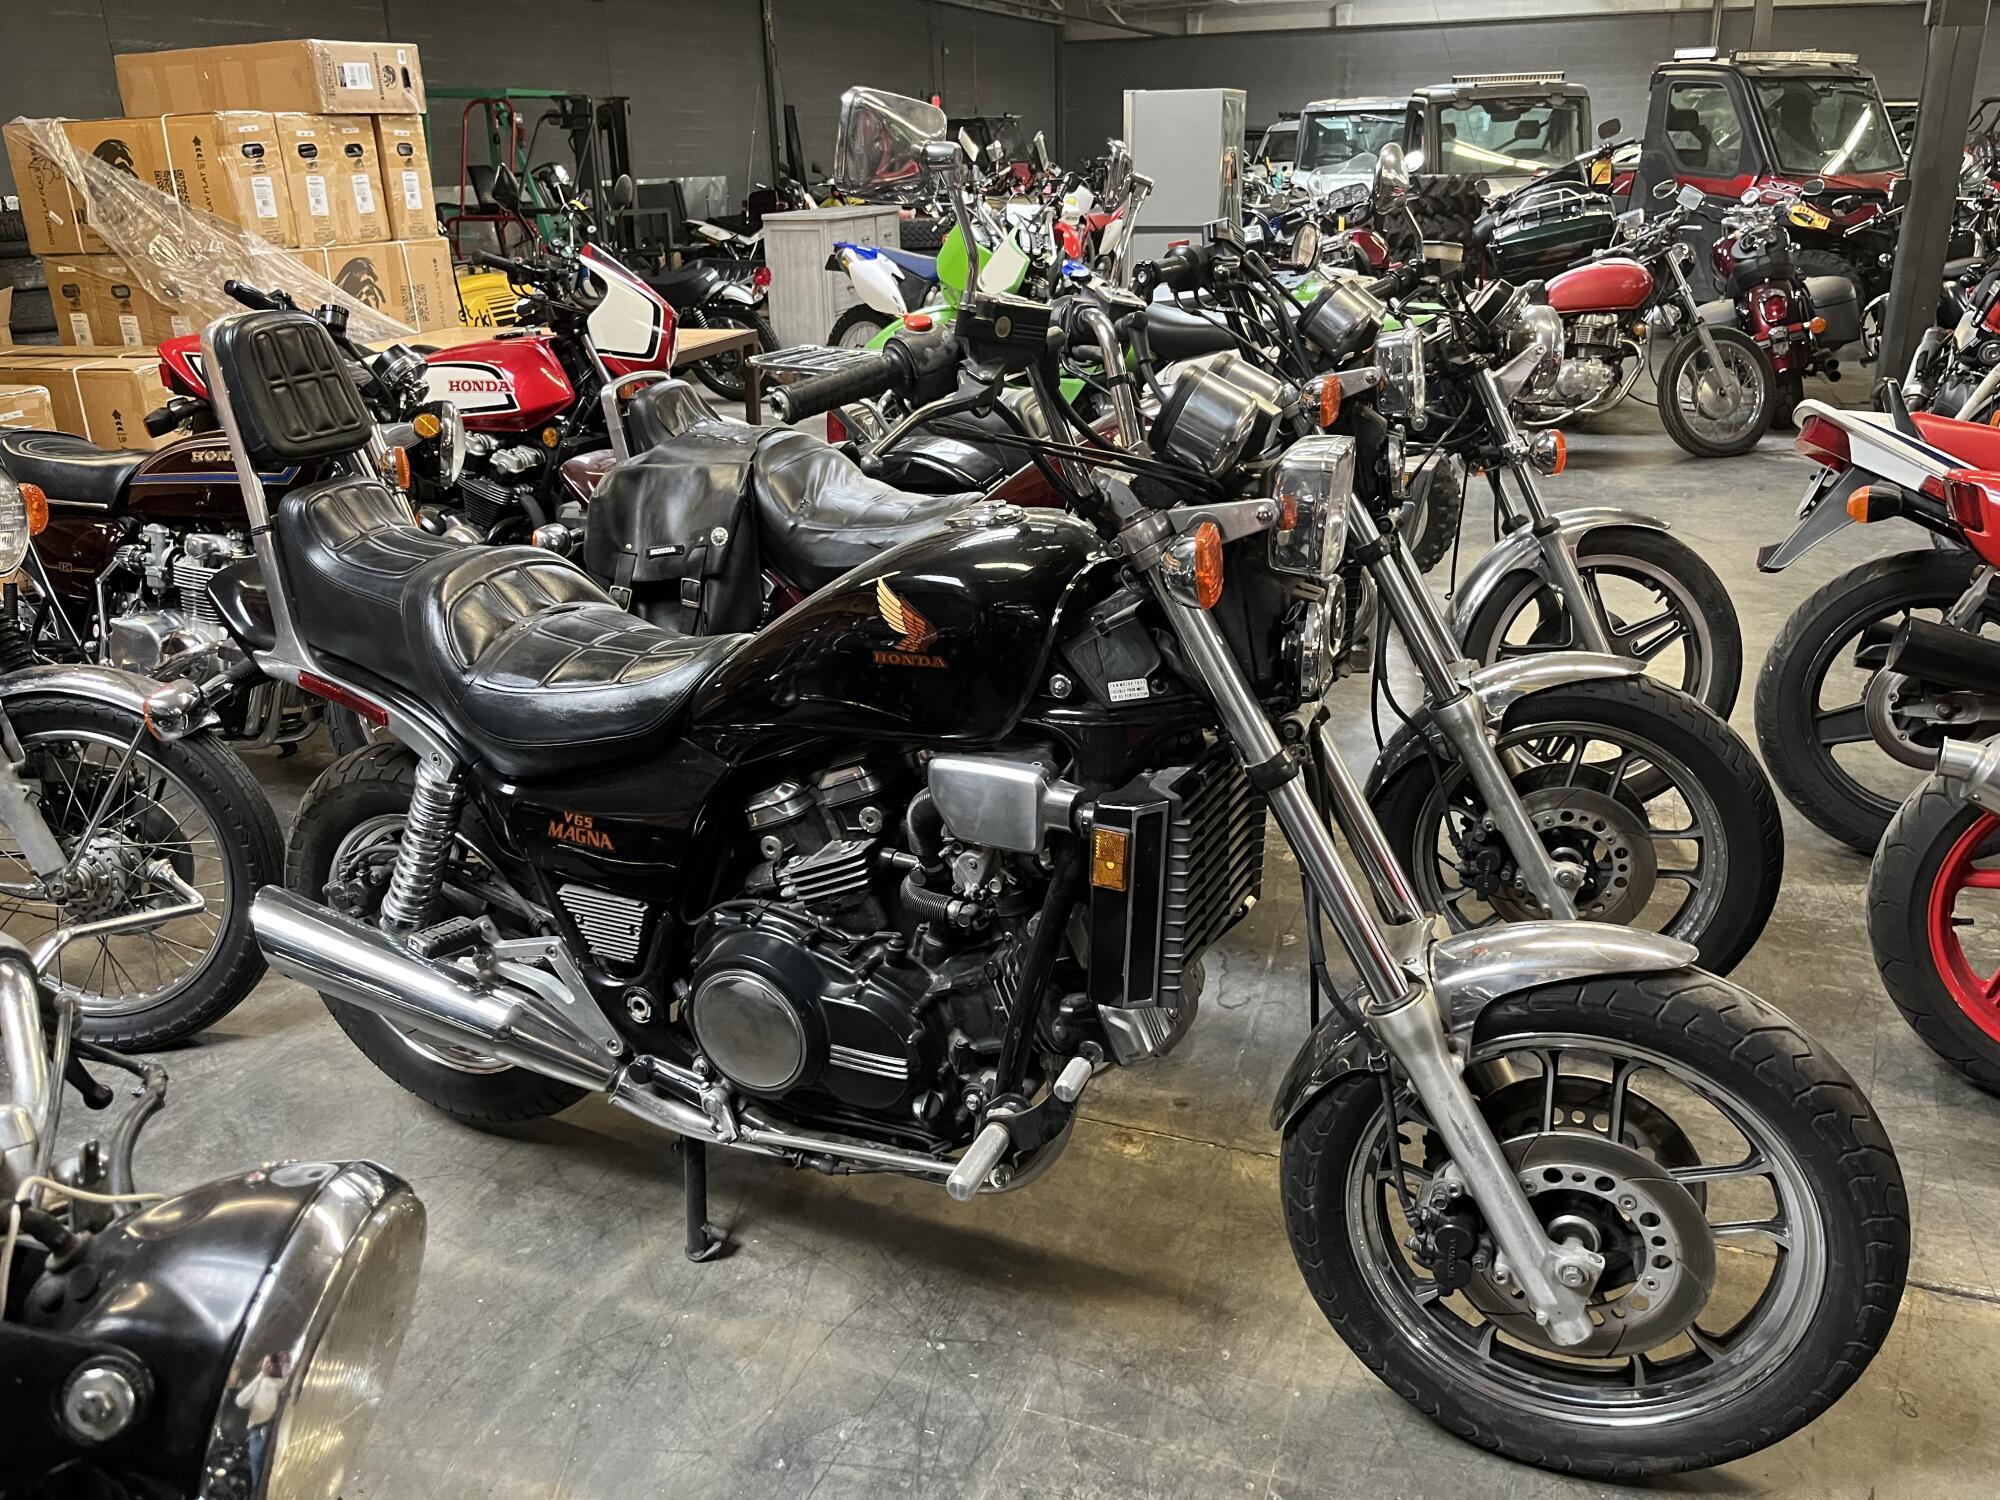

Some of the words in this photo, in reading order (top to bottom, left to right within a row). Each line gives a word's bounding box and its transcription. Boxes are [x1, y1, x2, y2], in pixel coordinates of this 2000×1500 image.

[200, 172, 209, 194] FLAT
[204, 196, 213, 212] LAY
[449, 380, 512, 392] HONDA
[191, 450, 233, 463] HON
[872, 650, 949, 669] HONDA
[564, 811, 592, 829] V65
[548, 821, 615, 851] MAGNA
